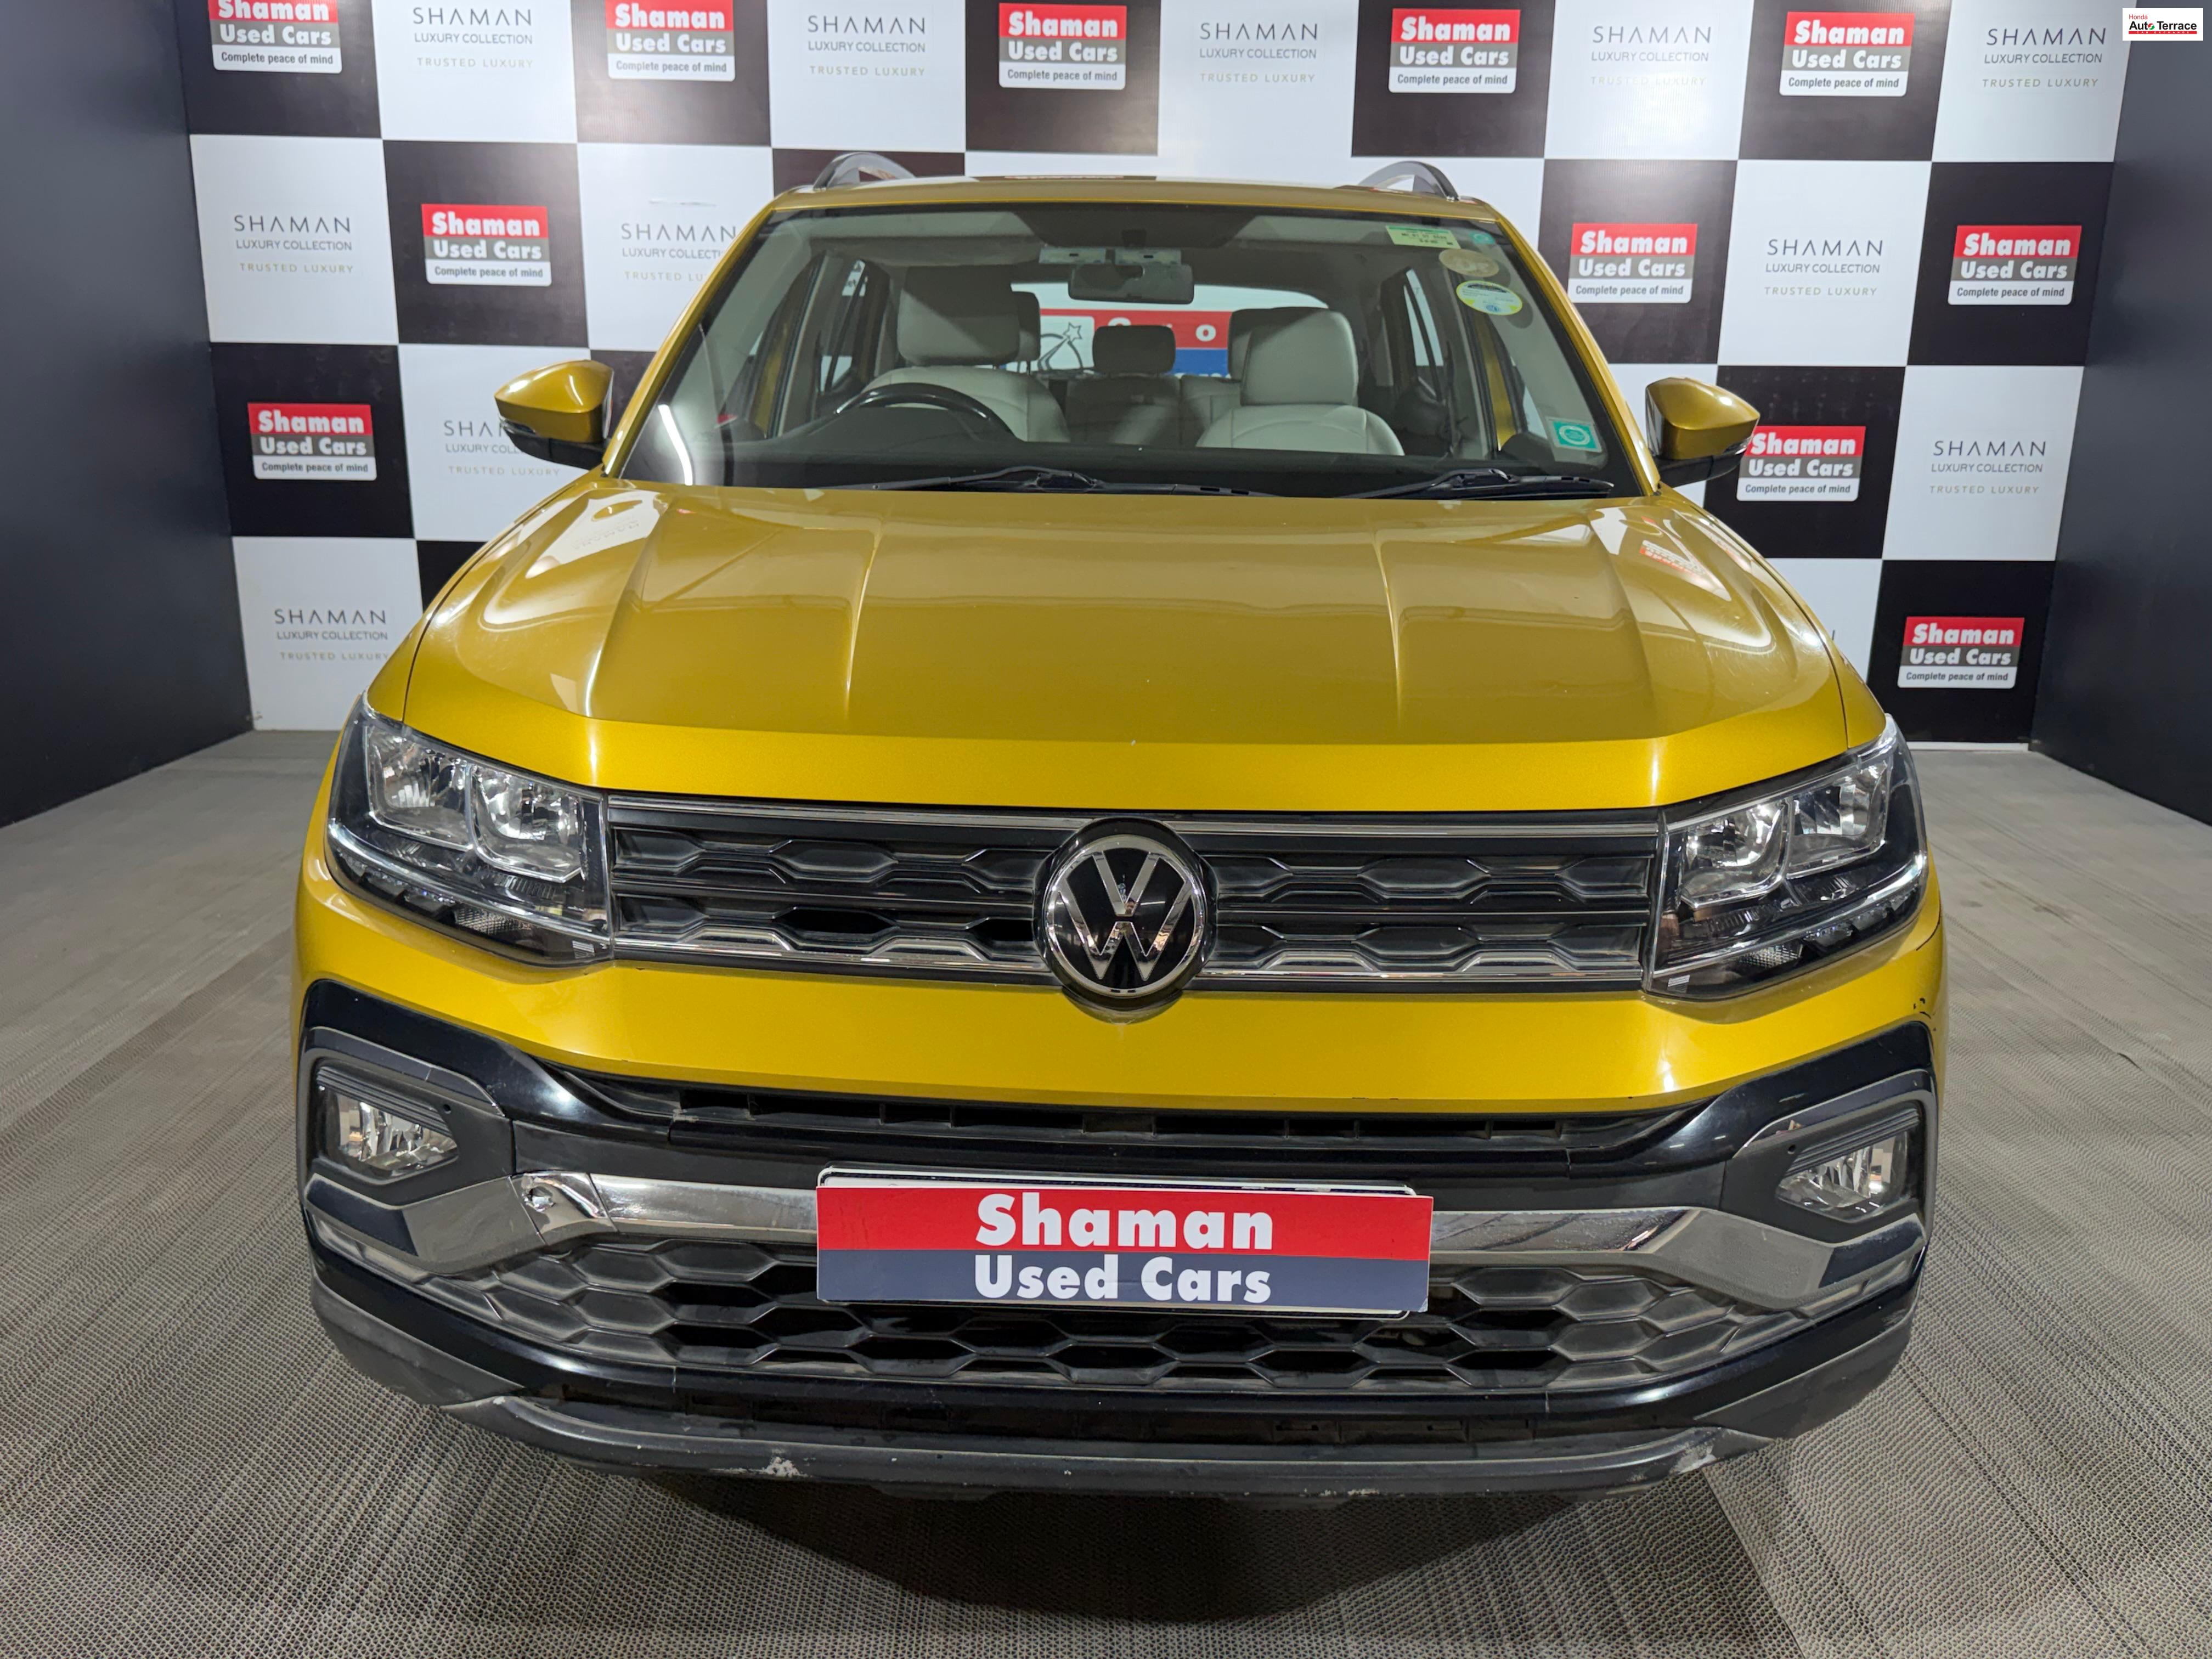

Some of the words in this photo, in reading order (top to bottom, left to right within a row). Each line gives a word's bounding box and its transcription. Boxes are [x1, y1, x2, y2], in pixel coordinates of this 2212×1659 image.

[218, 0, 331, 21] Shaman
[412, 7, 531, 25] SHAMAN
[614, 2, 725, 29] Shaman
[807, 15, 925, 33] SHAMAN
[1008, 10, 1118, 37] Shaman
[1200, 22, 1317, 40] SHAMAN
[1401, 16, 1510, 42] Shaman
[1794, 19, 1905, 45] Shaman
[220, 24, 275, 44] Used
[282, 25, 332, 46] Cars
[414, 33, 460, 43] LUXURY
[462, 33, 532, 44] COLLECTION
[616, 32, 670, 52] Used
[677, 33, 726, 53] Cars
[1593, 26, 1710, 43] SHAMAN
[1987, 27, 2105, 45] SHAMAN
[809, 41, 853, 51] LUXURY
[855, 42, 925, 52] COLLECTION
[1008, 41, 1062, 61] Used
[1069, 42, 1118, 62] Cars
[1200, 48, 1244, 58] LUXURY
[1247, 49, 1316, 58] COLLECTION
[221, 52, 264, 63] Complete
[268, 54, 295, 64] peace
[298, 54, 307, 63] of
[310, 55, 333, 64] mind
[417, 58, 476, 66] TRUSTED
[483, 59, 533, 67] LUXURY
[1400, 45, 1454, 65] Used
[1460, 46, 1509, 66] Cars
[1592, 52, 1637, 61] LUXURY
[1639, 52, 1708, 61] COLLECTION
[1792, 49, 1847, 69] Used
[1853, 50, 1901, 69] Cars
[1984, 54, 2030, 64] LUXURY
[2032, 53, 2102, 63] COLLECTION
[617, 60, 659, 71] Complete
[662, 63, 689, 72] peace
[692, 63, 701, 71] of
[704, 63, 726, 72] mind
[810, 66, 868, 75] TRUSTED
[875, 67, 925, 76] LUXURY
[1008, 69, 1049, 80] Complete
[1053, 71, 1079, 81] peace
[1084, 71, 1092, 80] of
[1095, 71, 1116, 81] mind
[1200, 73, 1257, 82] TRUSTED
[1265, 74, 1314, 82] LUXURY
[1397, 74, 1440, 84] Complete
[1443, 76, 1470, 85] peace
[1473, 75, 1482, 83] of
[1485, 75, 1507, 84] mind
[1788, 77, 1831, 88] Complete
[1834, 78, 1861, 88] peace
[1864, 78, 1874, 87] of
[1876, 78, 1898, 87] mind
[1982, 78, 2041, 87] TRUSTED
[2047, 78, 2098, 87] LUXURY
[233, 215, 350, 233] SHAMAN
[432, 211, 540, 236] Shaman
[621, 223, 736, 241] SHAMAN
[236, 240, 281, 249] LUXURY
[283, 240, 352, 250] COLLECTION
[433, 239, 487, 258] Used
[493, 240, 542, 259] Cars
[1580, 230, 1688, 254] Shaman
[1767, 239, 1882, 255] SHAMAN
[1963, 232, 2070, 256] Shaman
[622, 248, 667, 257] LUXURY
[239, 263, 297, 272] TRUSTED
[435, 266, 476, 276] Complete
[479, 268, 506, 278] peace
[509, 268, 518, 276] of
[520, 268, 543, 277] mind
[1578, 257, 1632, 276] Used
[1638, 258, 1685, 276] Cars
[1766, 263, 1809, 272] LUXURY
[1812, 264, 1880, 273] COLLECTION
[1961, 260, 2015, 279] Used
[2020, 261, 2068, 279] Cars
[1576, 285, 1617, 295] Complete
[1620, 286, 1646, 295] peace
[1764, 286, 1821, 295] TRUSTED
[1957, 287, 1999, 297] Complete
[2001, 289, 2028, 297] peace
[2042, 287, 2064, 296] mind
[258, 409, 364, 433] Shaman
[444, 420, 502, 437] SHA
[260, 436, 313, 455] Used
[319, 437, 366, 455] Cars
[446, 443, 488, 453] LUXURY
[1750, 431, 1856, 455] Shaman
[1933, 441, 2045, 455] SHAMAN
[262, 462, 303, 472] Complete
[306, 464, 332, 472] peace
[1748, 458, 1801, 476] Used
[1807, 459, 1853, 477] Cars
[1931, 464, 1974, 472] LUXURY
[1976, 464, 2042, 472] COLLECTION
[1745, 484, 1786, 494] Complete
[1789, 486, 1815, 494] peace
[273, 609, 386, 624] SHAMAN
[276, 631, 320, 639] LUXURY
[321, 631, 387, 640] COLLECTION
[1912, 623, 2015, 645] Shaman
[1910, 647, 1961, 664] Used
[1966, 648, 2011, 665] Cars
[1906, 672, 1946, 681] Complete
[975, 1192, 1273, 1250] Shaman
[975, 1254, 1119, 1300] Used
[1141, 1256, 1271, 1304] Cars
